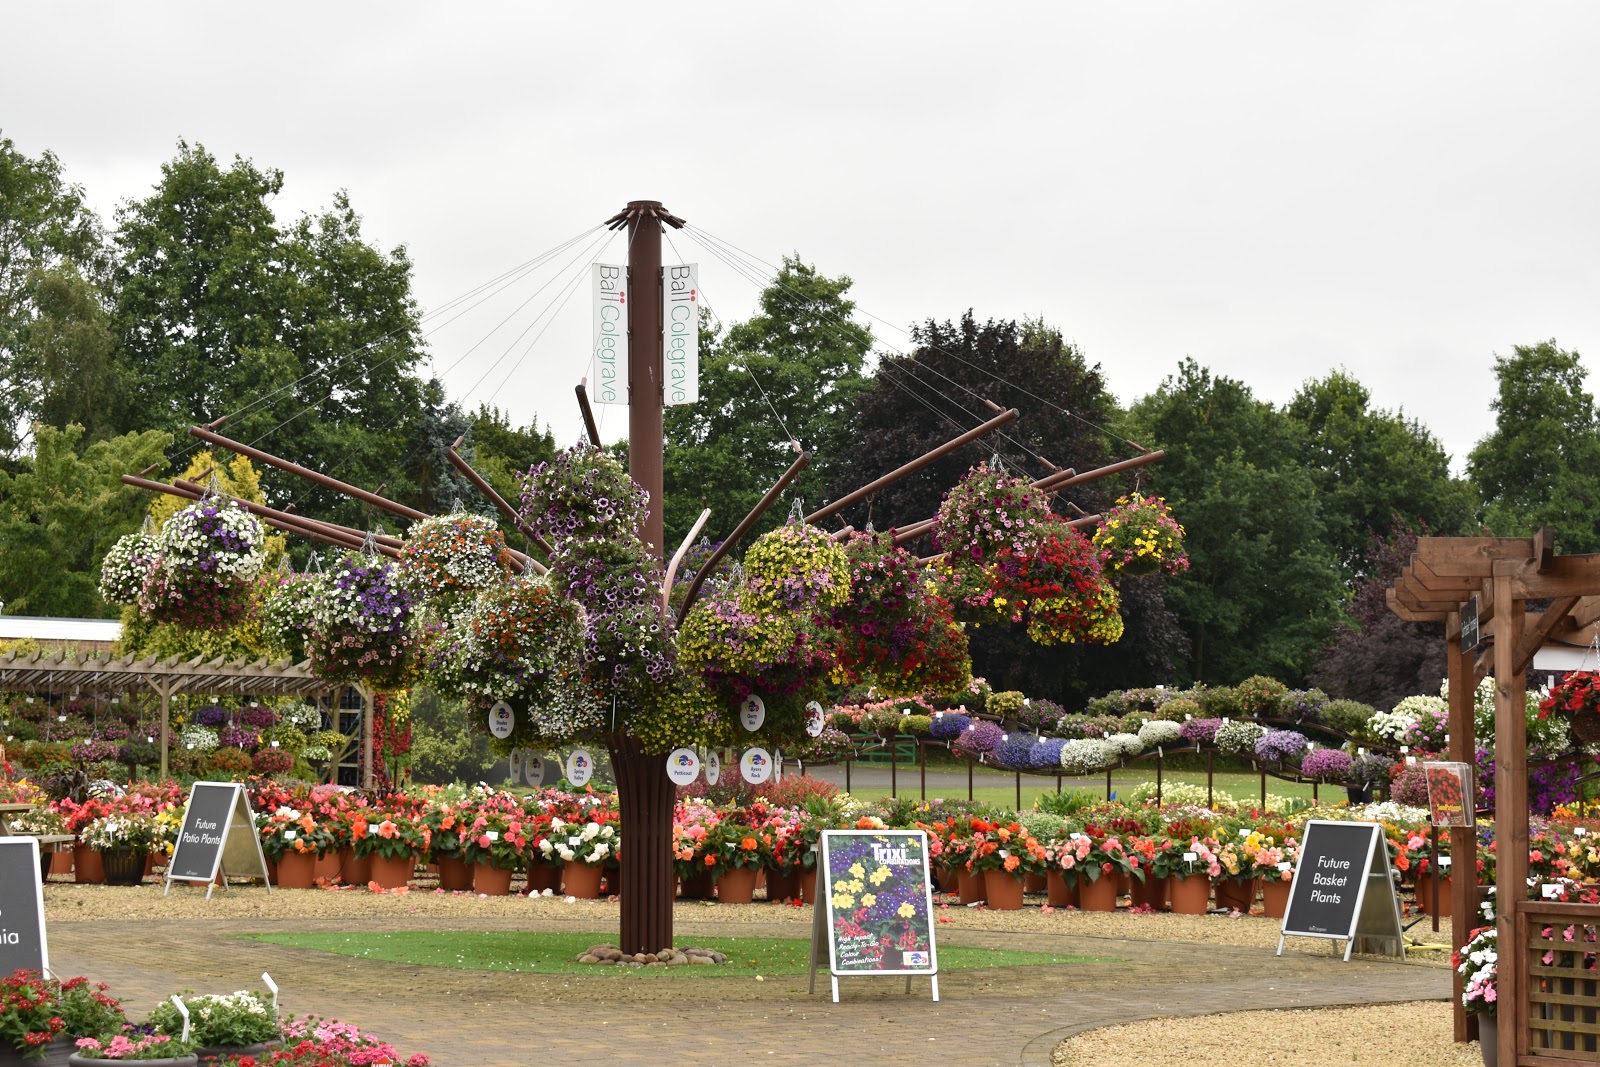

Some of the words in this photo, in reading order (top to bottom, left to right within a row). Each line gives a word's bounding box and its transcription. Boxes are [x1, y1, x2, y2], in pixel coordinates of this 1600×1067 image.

[600, 266, 622, 302] Ball
[671, 266, 692, 302] Ball
[597, 305, 620, 402] Colegrave
[667, 305, 690, 402] Colegrave
[195, 818, 217, 830] Future
[183, 832, 200, 843] Patio
[200, 833, 221, 845] Plants
[870, 843, 907, 861] Trixi
[1317, 855, 1350, 870] Future
[1312, 872, 1348, 887] Basket
[1310, 889, 1341, 904] Plants
[840, 950, 859, 958] Colour
